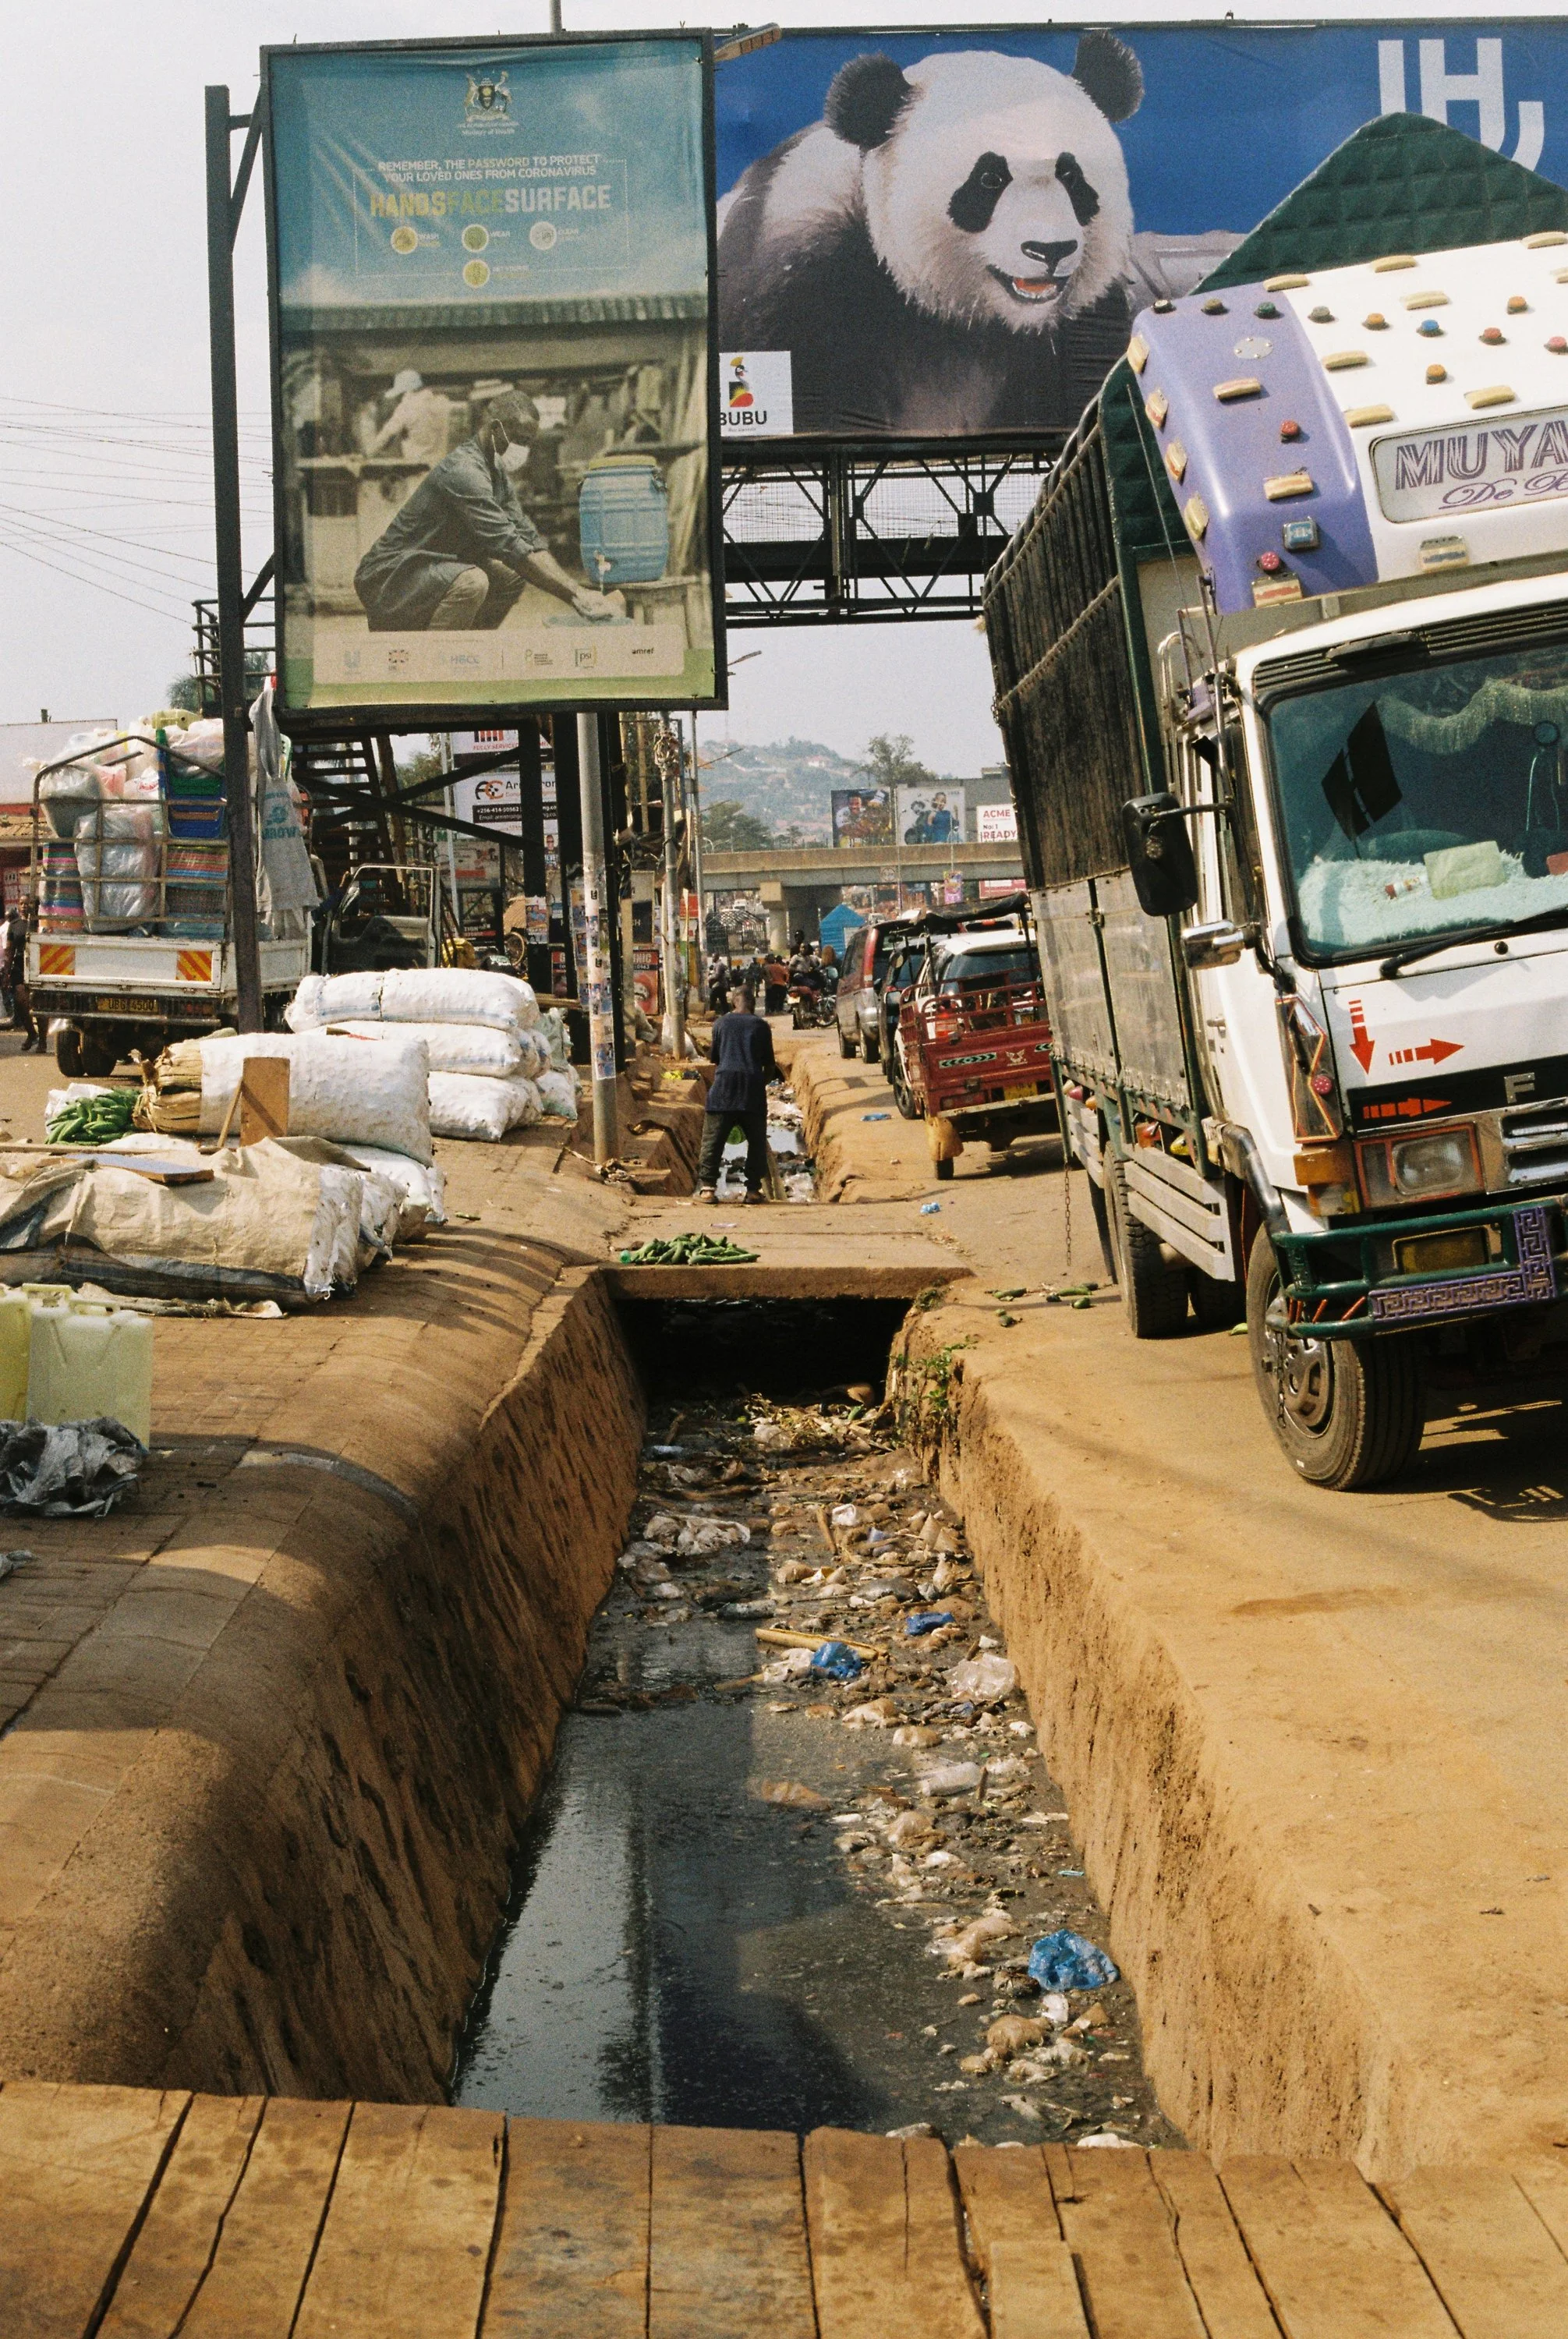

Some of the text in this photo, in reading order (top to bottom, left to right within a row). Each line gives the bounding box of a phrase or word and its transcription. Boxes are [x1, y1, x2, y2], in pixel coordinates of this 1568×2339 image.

[377, 154, 600, 172] REMEMBER, THE PASSWORD TO PROTECT
[382, 165, 596, 184] YOUR LOVED ONES FROM CORONAVIRUS
[1395, 419, 1568, 491] MUYA
[579, 652, 592, 663] psi
[632, 647, 654, 656] amref
[983, 809, 1011, 818] ACME
[983, 830, 1017, 840] READY
[1503, 1072, 1536, 1104] F
